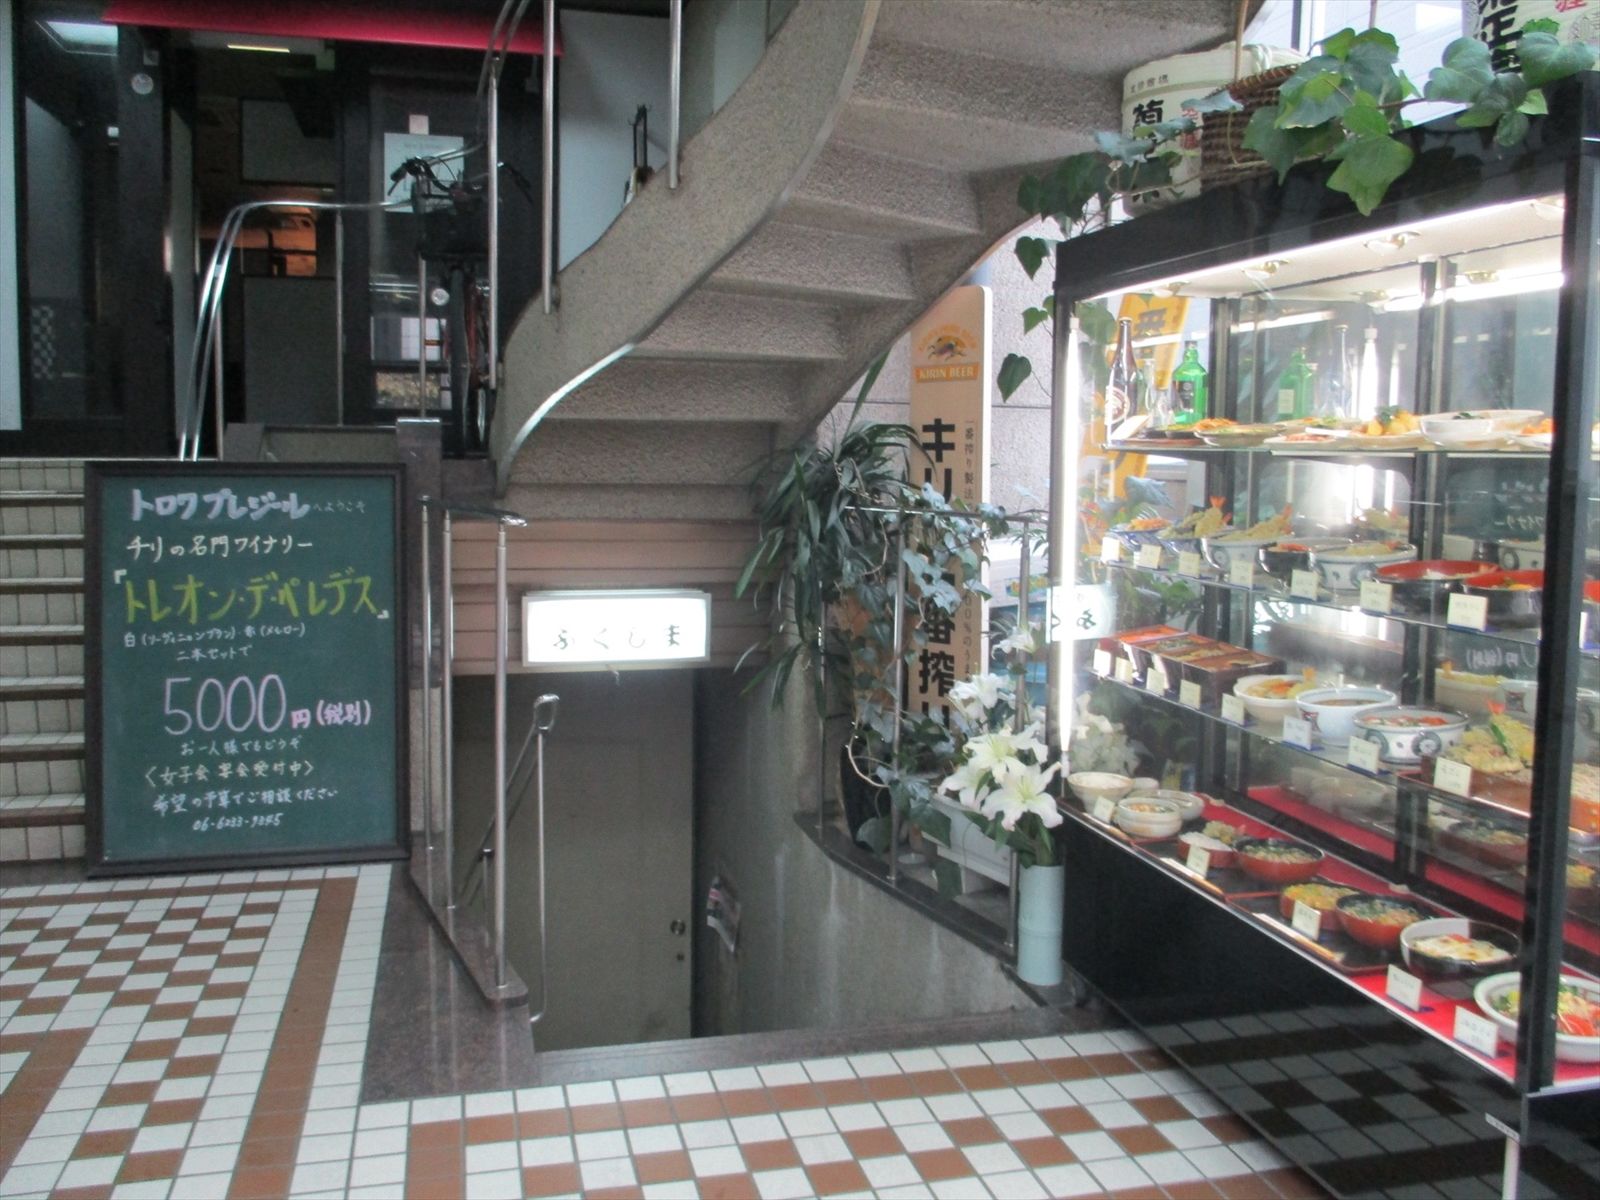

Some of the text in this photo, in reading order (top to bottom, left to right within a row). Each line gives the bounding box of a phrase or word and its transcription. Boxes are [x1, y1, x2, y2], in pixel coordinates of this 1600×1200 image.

[920, 366, 975, 380] KIRIN BEER
[126, 535, 313, 563] チリの名門ワイナリー
[553, 624, 680, 650] ふくしま
